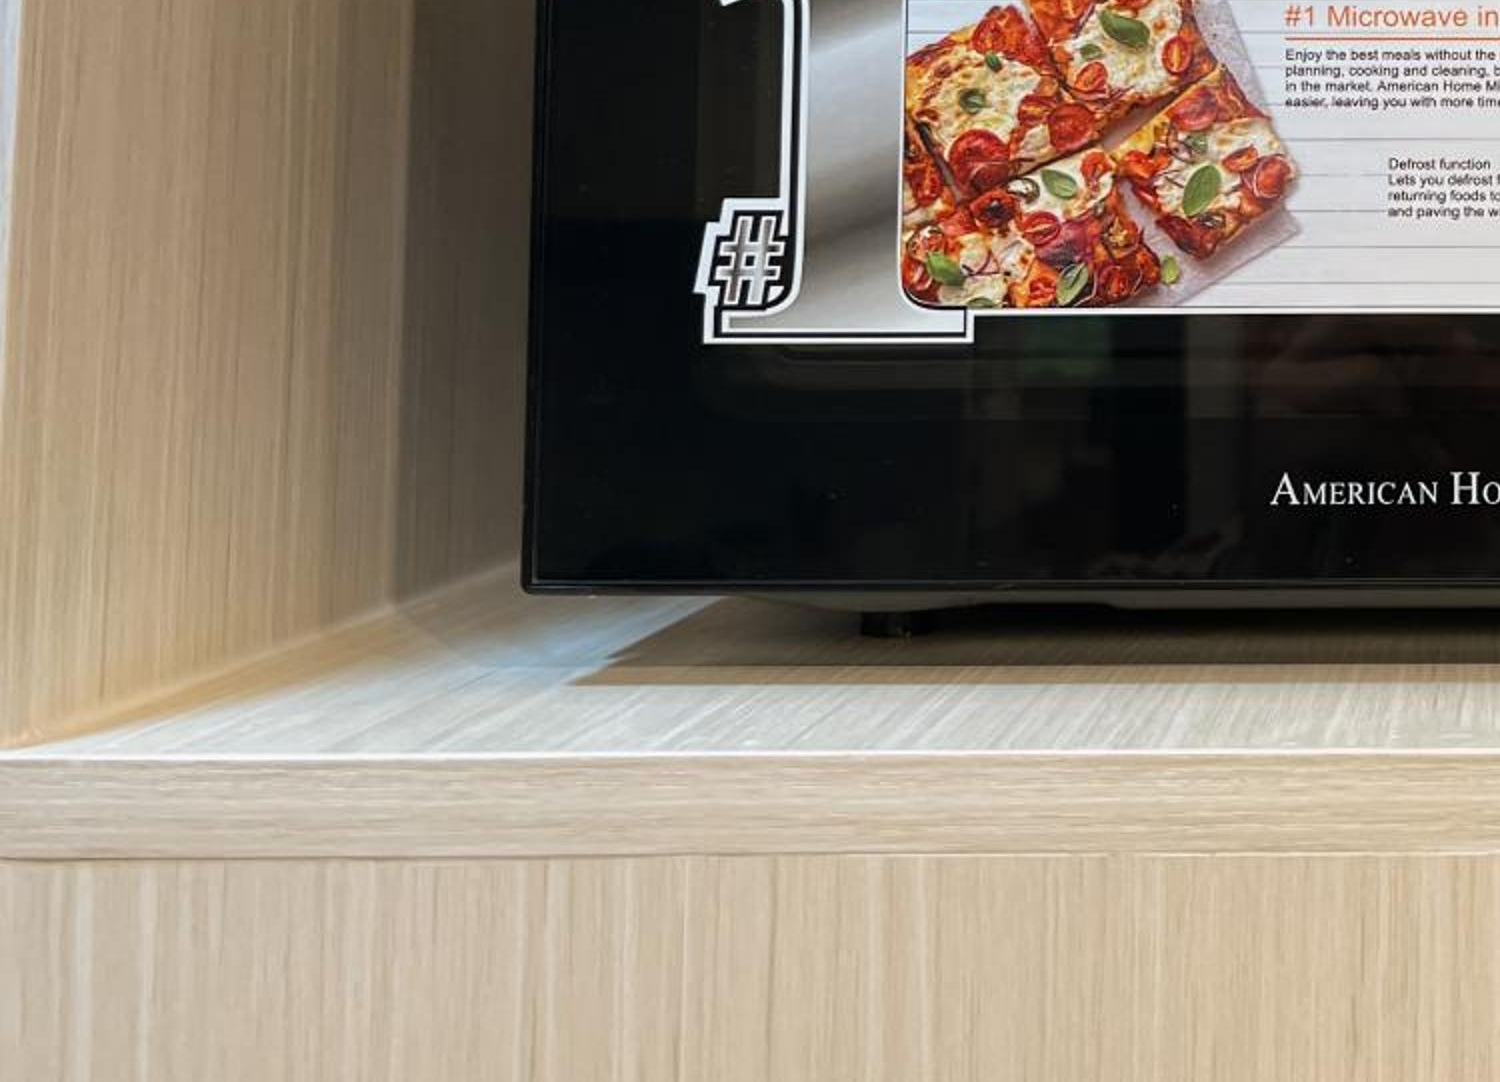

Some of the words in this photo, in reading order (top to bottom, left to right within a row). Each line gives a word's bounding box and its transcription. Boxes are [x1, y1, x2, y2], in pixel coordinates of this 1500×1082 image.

[1328, 5, 1468, 28] Microwave
[1477, 5, 1500, 28] in
[1285, 49, 1322, 63] Enjoy
[1326, 49, 1346, 60] the
[1350, 49, 1378, 60] best
[1382, 49, 1421, 60] meals
[1424, 49, 1472, 60] without
[1475, 49, 1496, 60] the
[1349, 65, 1398, 79] cooking
[1404, 65, 1428, 76] and
[1285, 81, 1296, 92] in
[1300, 81, 1320, 92] the
[1377, 81, 1438, 92] American
[1444, 81, 1482, 92] Home
[1332, 97, 1378, 110] leaving
[1382, 100, 1406, 110] you
[1410, 97, 1436, 108] with
[1440, 100, 1474, 108] more
[1388, 158, 1436, 170] Defrost
[1439, 158, 1491, 170] function
[1388, 174, 1416, 186] Lets
[1420, 177, 1444, 188] you
[1448, 174, 1492, 186] defrost
[1388, 190, 1446, 204] returning
[1450, 190, 1486, 202] foods
[1388, 206, 1412, 218] and
[1416, 206, 1460, 220] paving
[1464, 206, 1484, 218] the
[1270, 472, 1438, 505] AMERICAN
